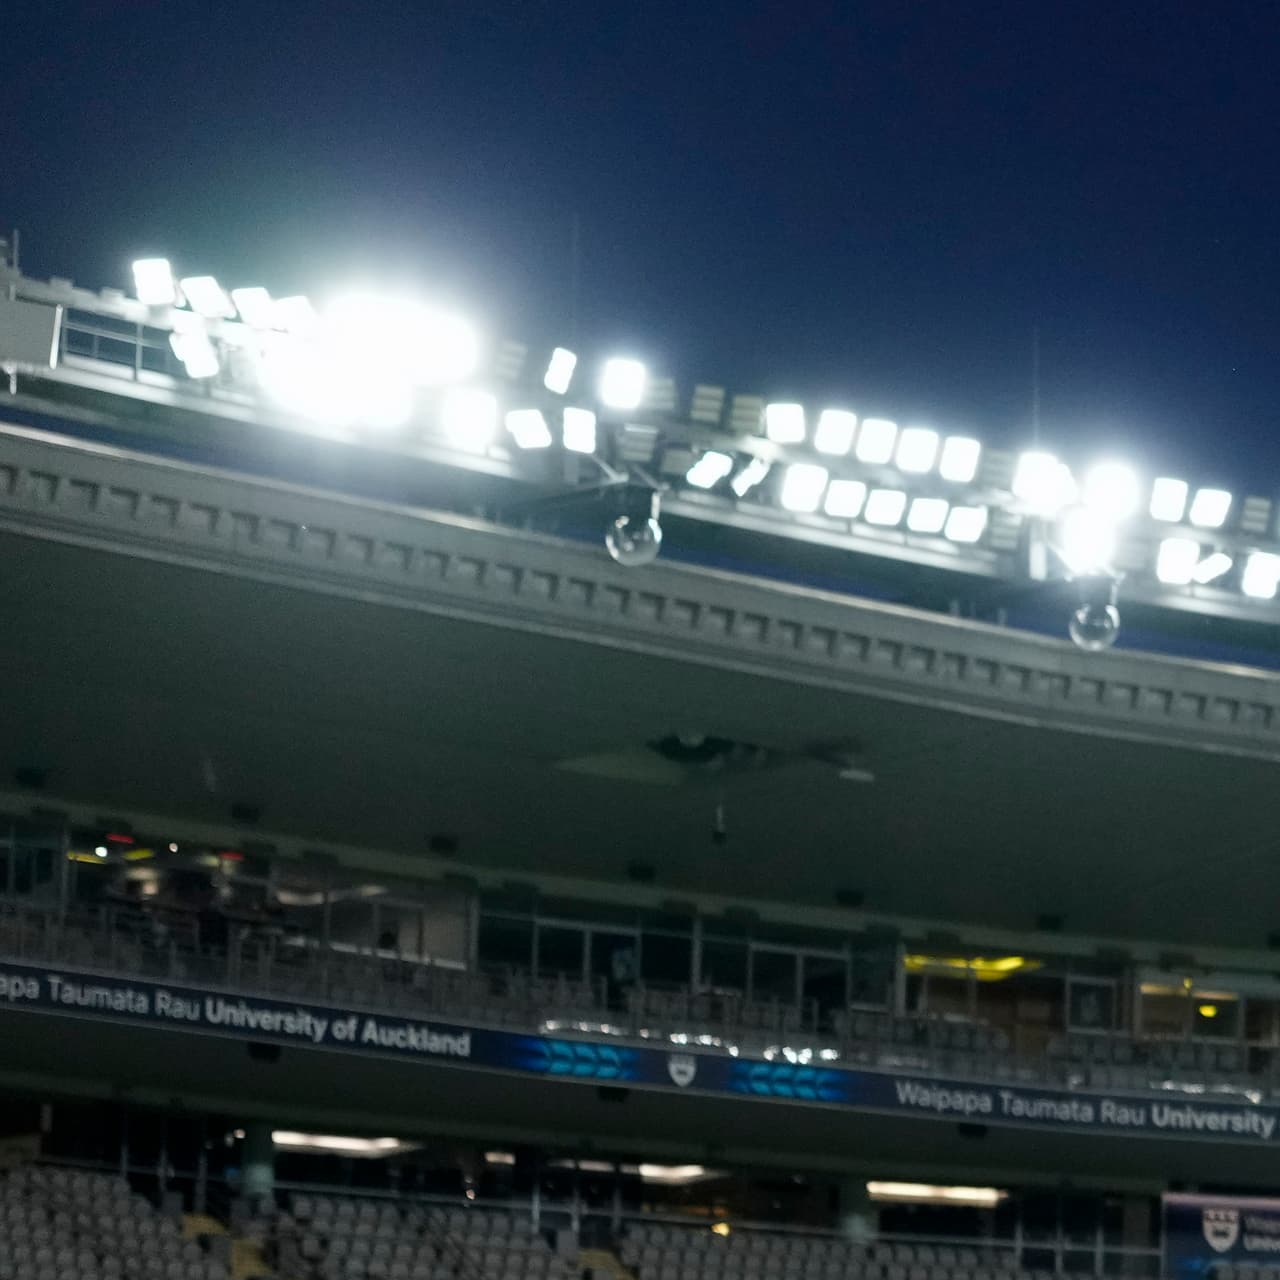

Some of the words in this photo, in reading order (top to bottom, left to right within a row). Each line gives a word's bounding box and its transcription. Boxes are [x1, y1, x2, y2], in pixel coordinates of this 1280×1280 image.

[48, 974, 149, 1014] Taumata
[155, 990, 200, 1021] Rau
[205, 997, 328, 1043] University
[331, 1016, 358, 1042] of
[361, 1020, 471, 1057] Auckland
[1000, 1090, 1094, 1123] Taumata
[1101, 1100, 1146, 1126] Rau
[1152, 1104, 1276, 1139] University
